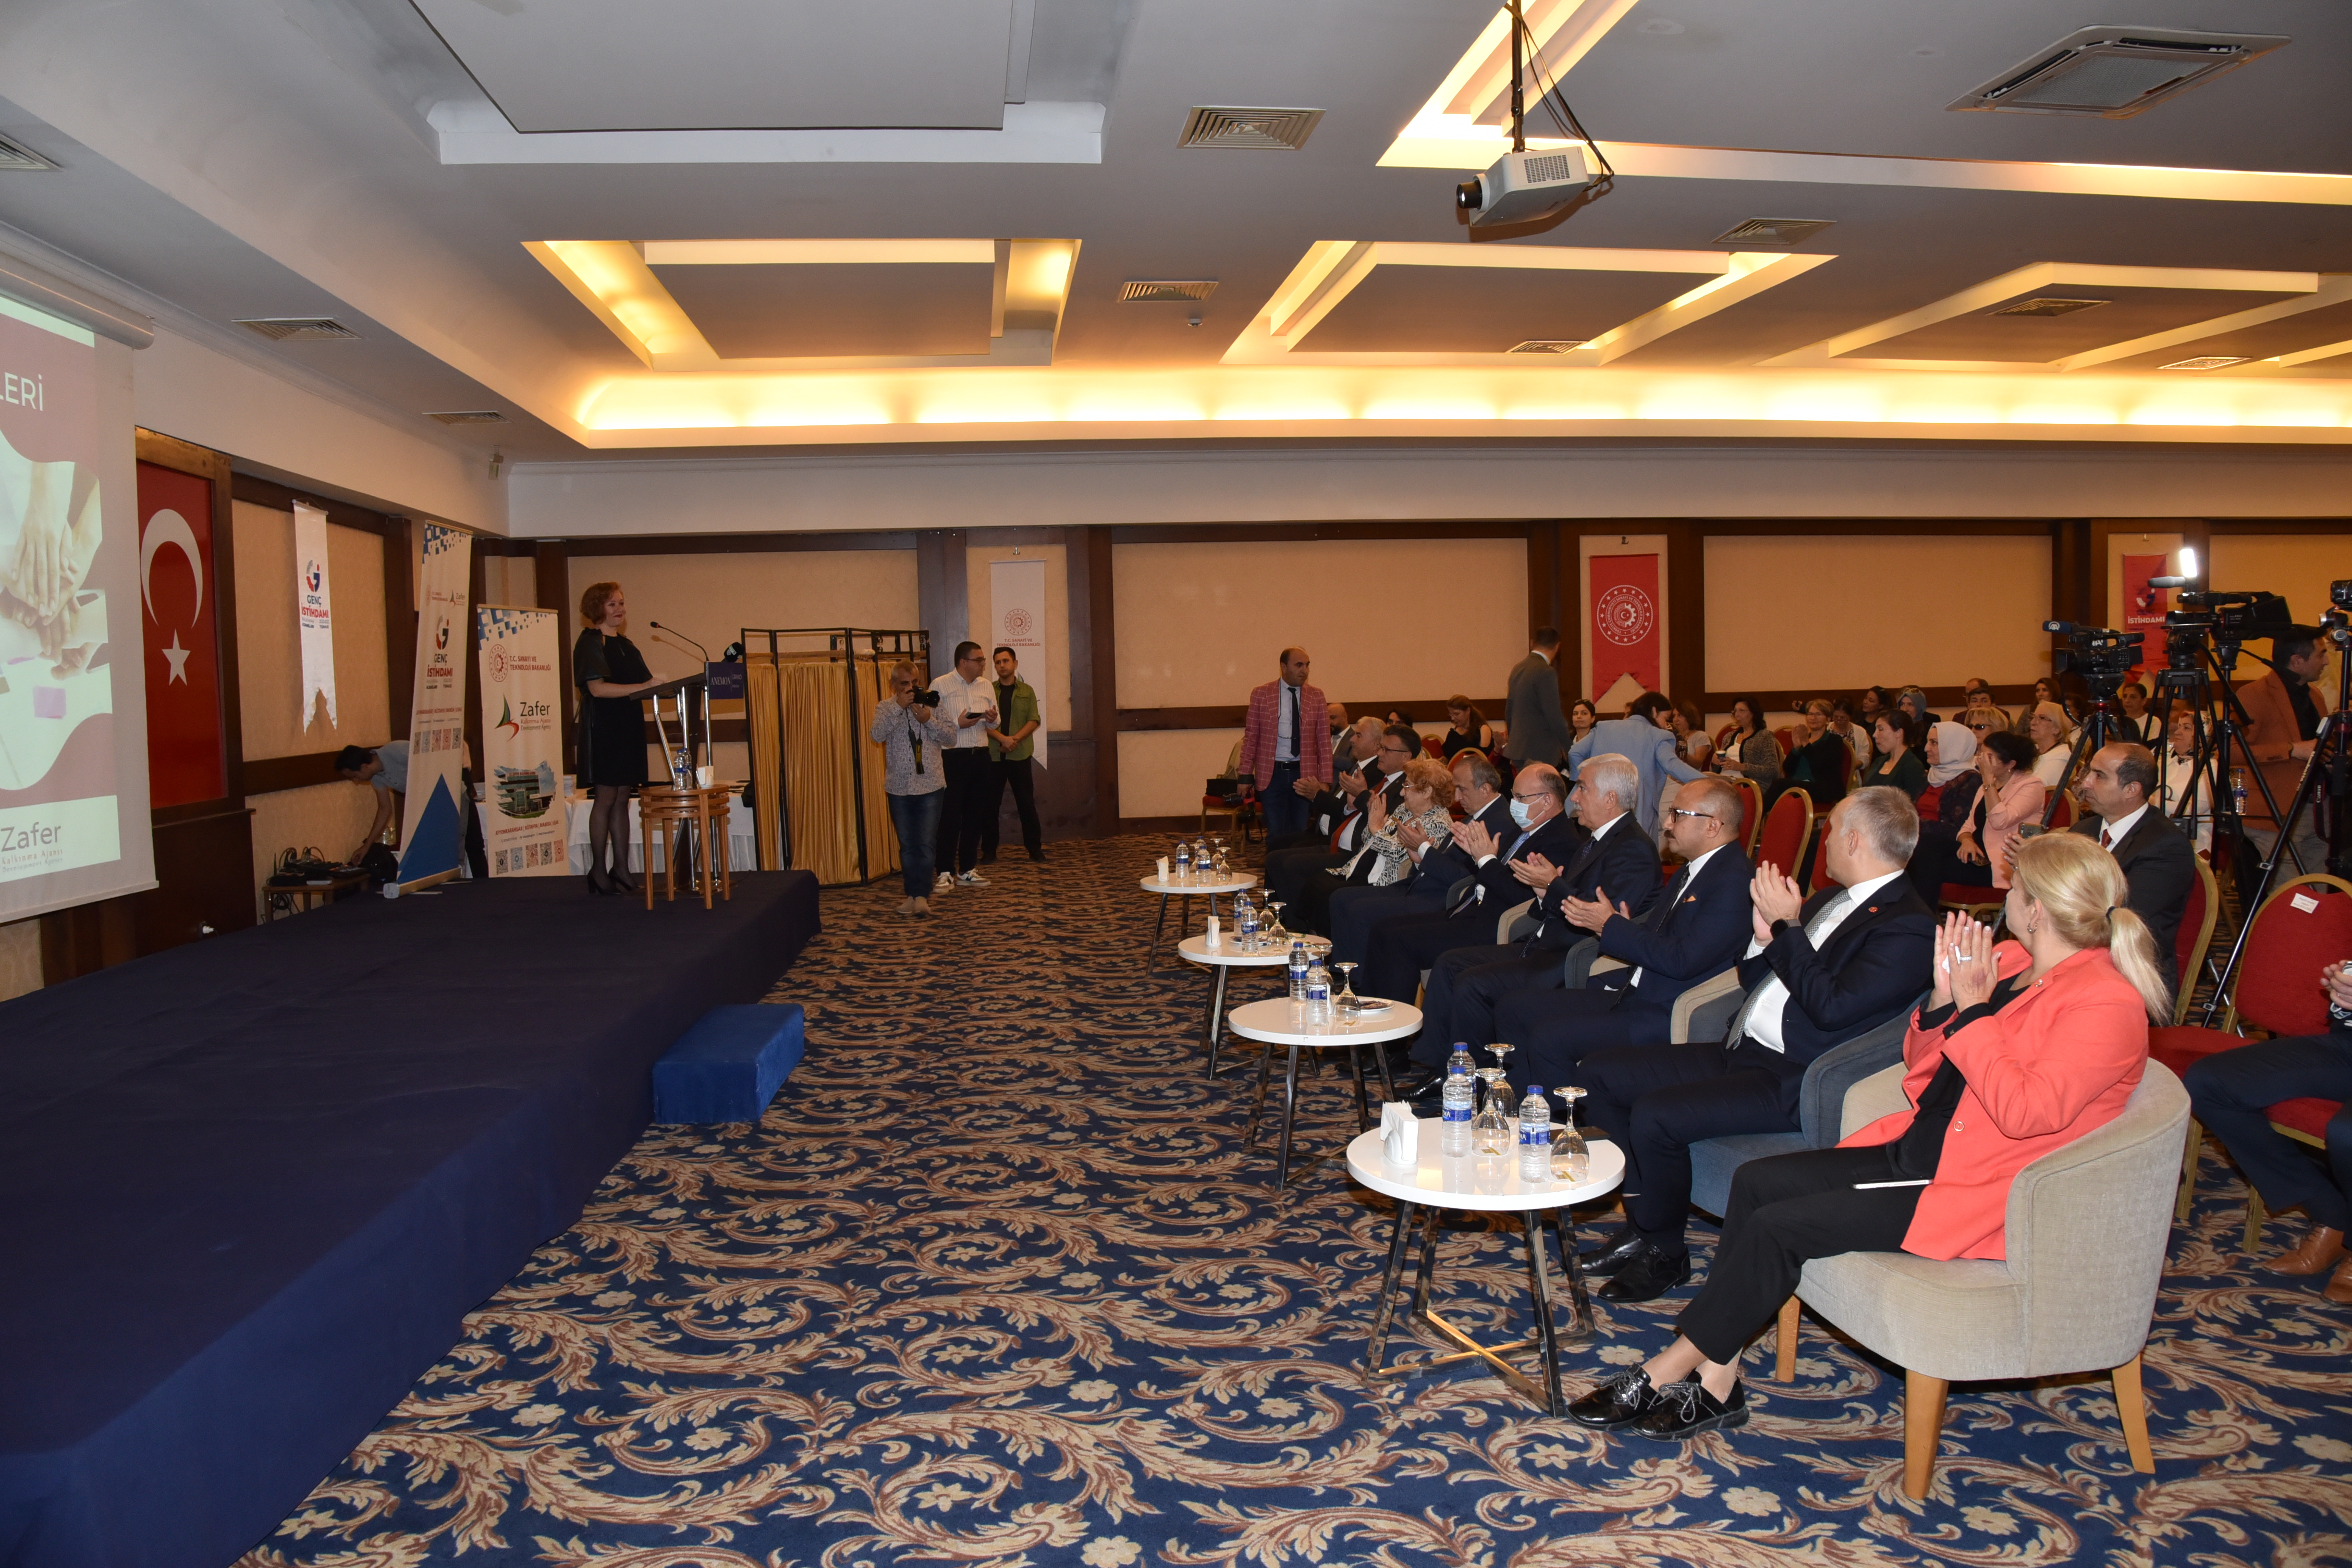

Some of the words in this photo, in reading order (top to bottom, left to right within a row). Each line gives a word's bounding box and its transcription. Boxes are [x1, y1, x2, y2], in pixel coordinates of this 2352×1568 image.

[0, 372, 43, 411] ERİ
[307, 595, 322, 608] GENÇ
[301, 603, 329, 618] İSTİHDAMI
[2128, 616, 2165, 624] İSTİHDAMI
[434, 653, 448, 666] GENÇ
[427, 664, 453, 677] İSTİHDAMI
[520, 701, 550, 717] Zafer
[1, 822, 61, 852] Zafer
